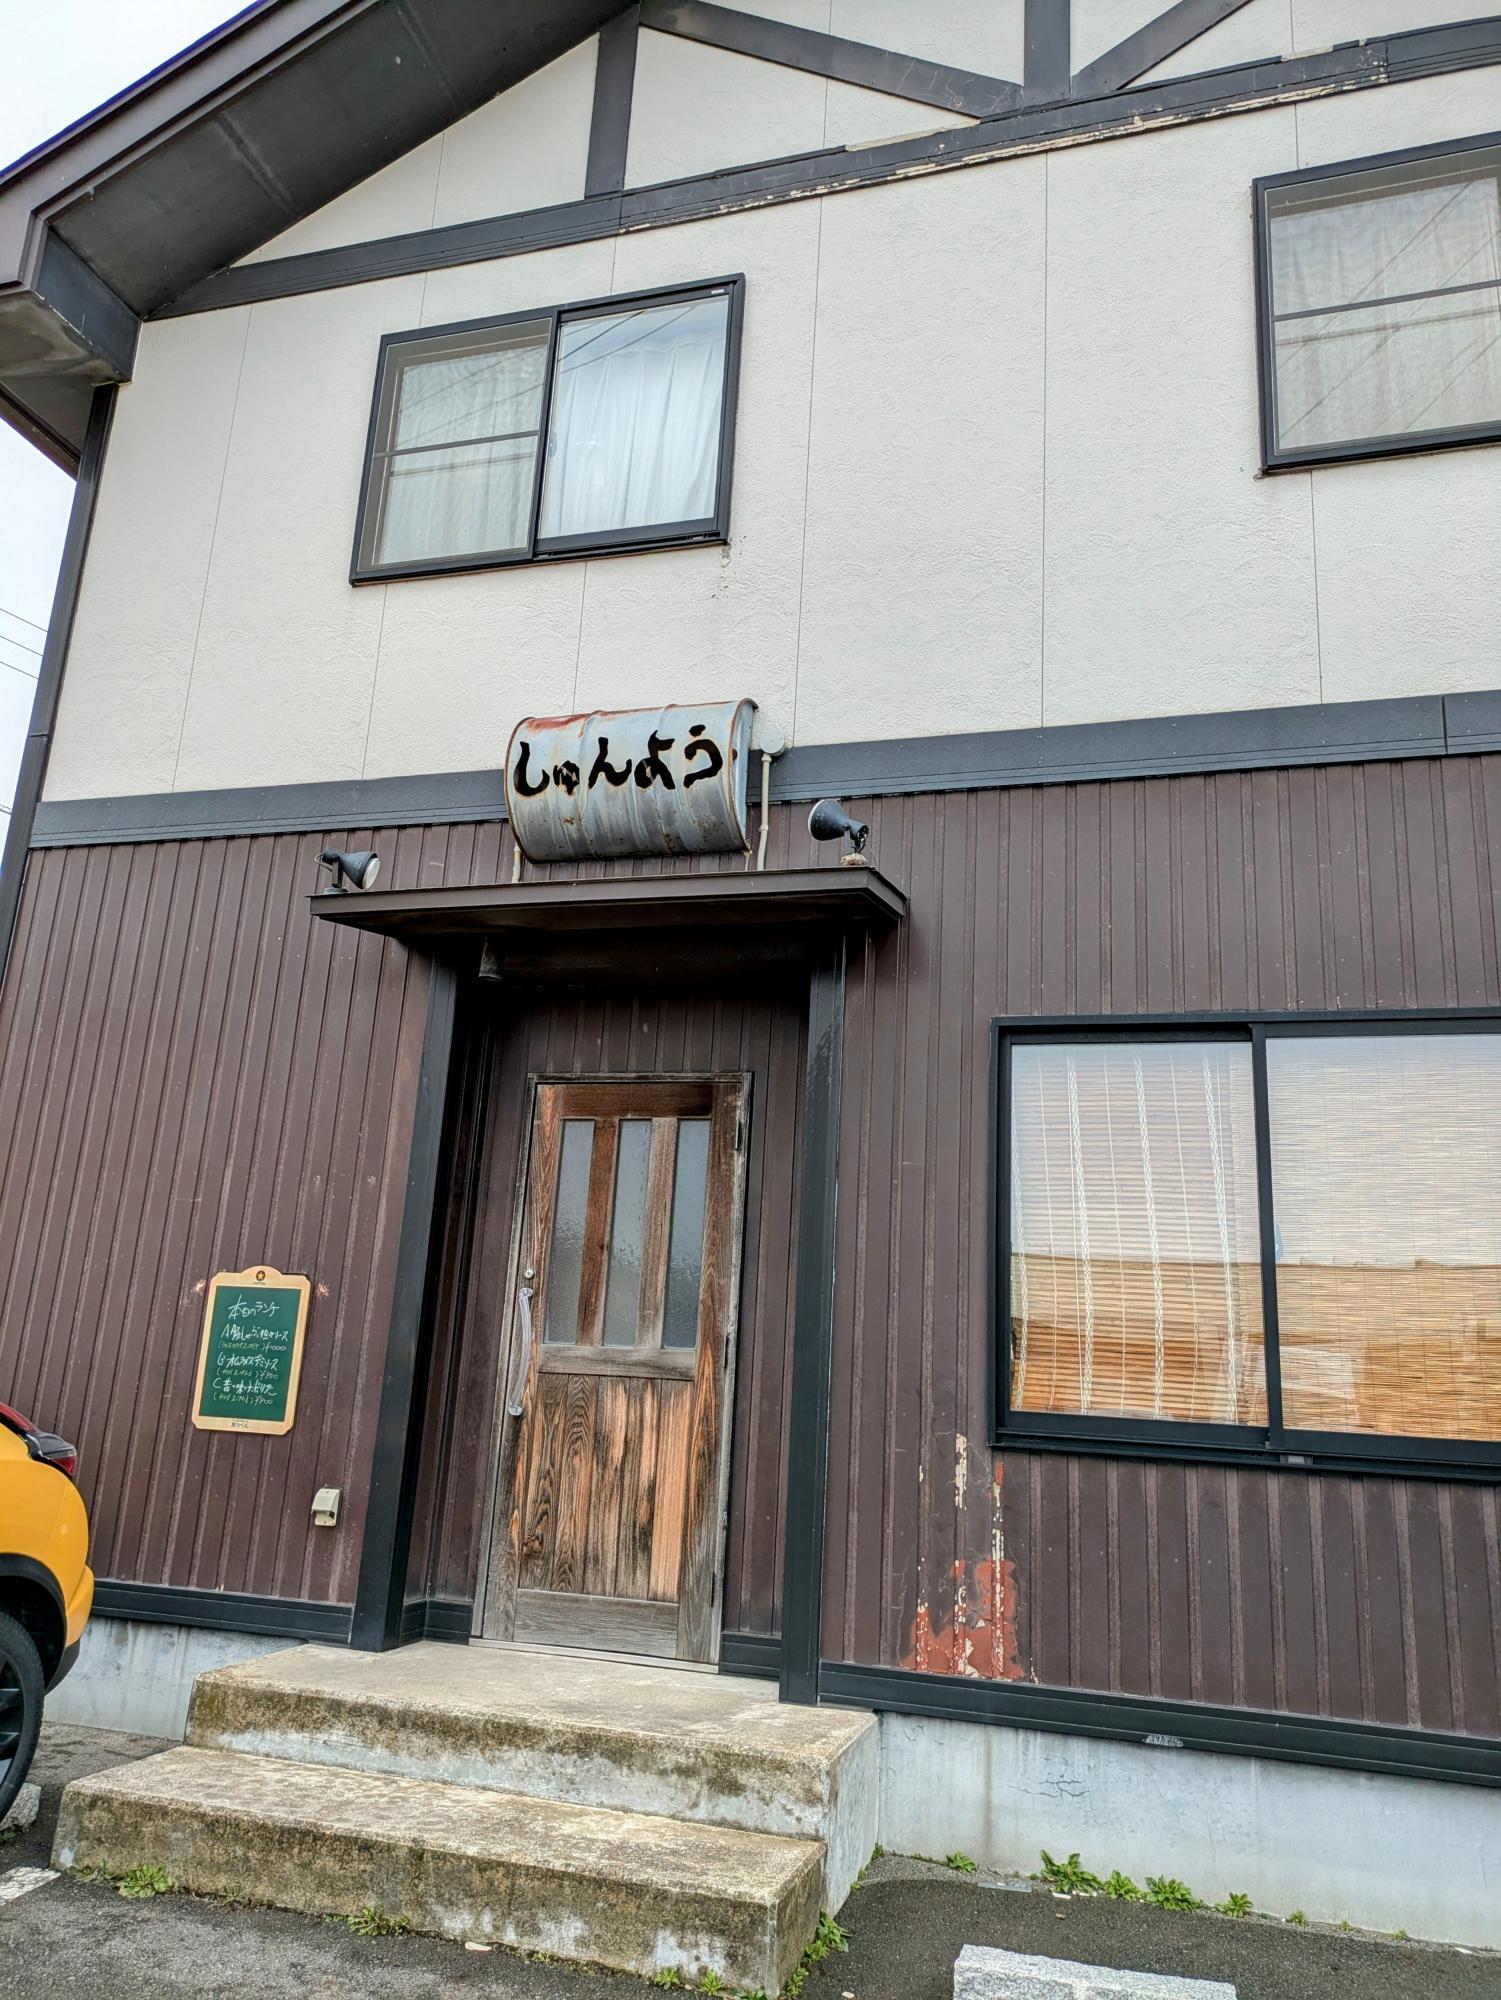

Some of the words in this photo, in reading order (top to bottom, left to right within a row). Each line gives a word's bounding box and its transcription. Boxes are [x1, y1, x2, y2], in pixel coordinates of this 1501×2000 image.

[513, 724, 723, 796] しゅんよう
[228, 1294, 280, 1319] 本日のランチ
